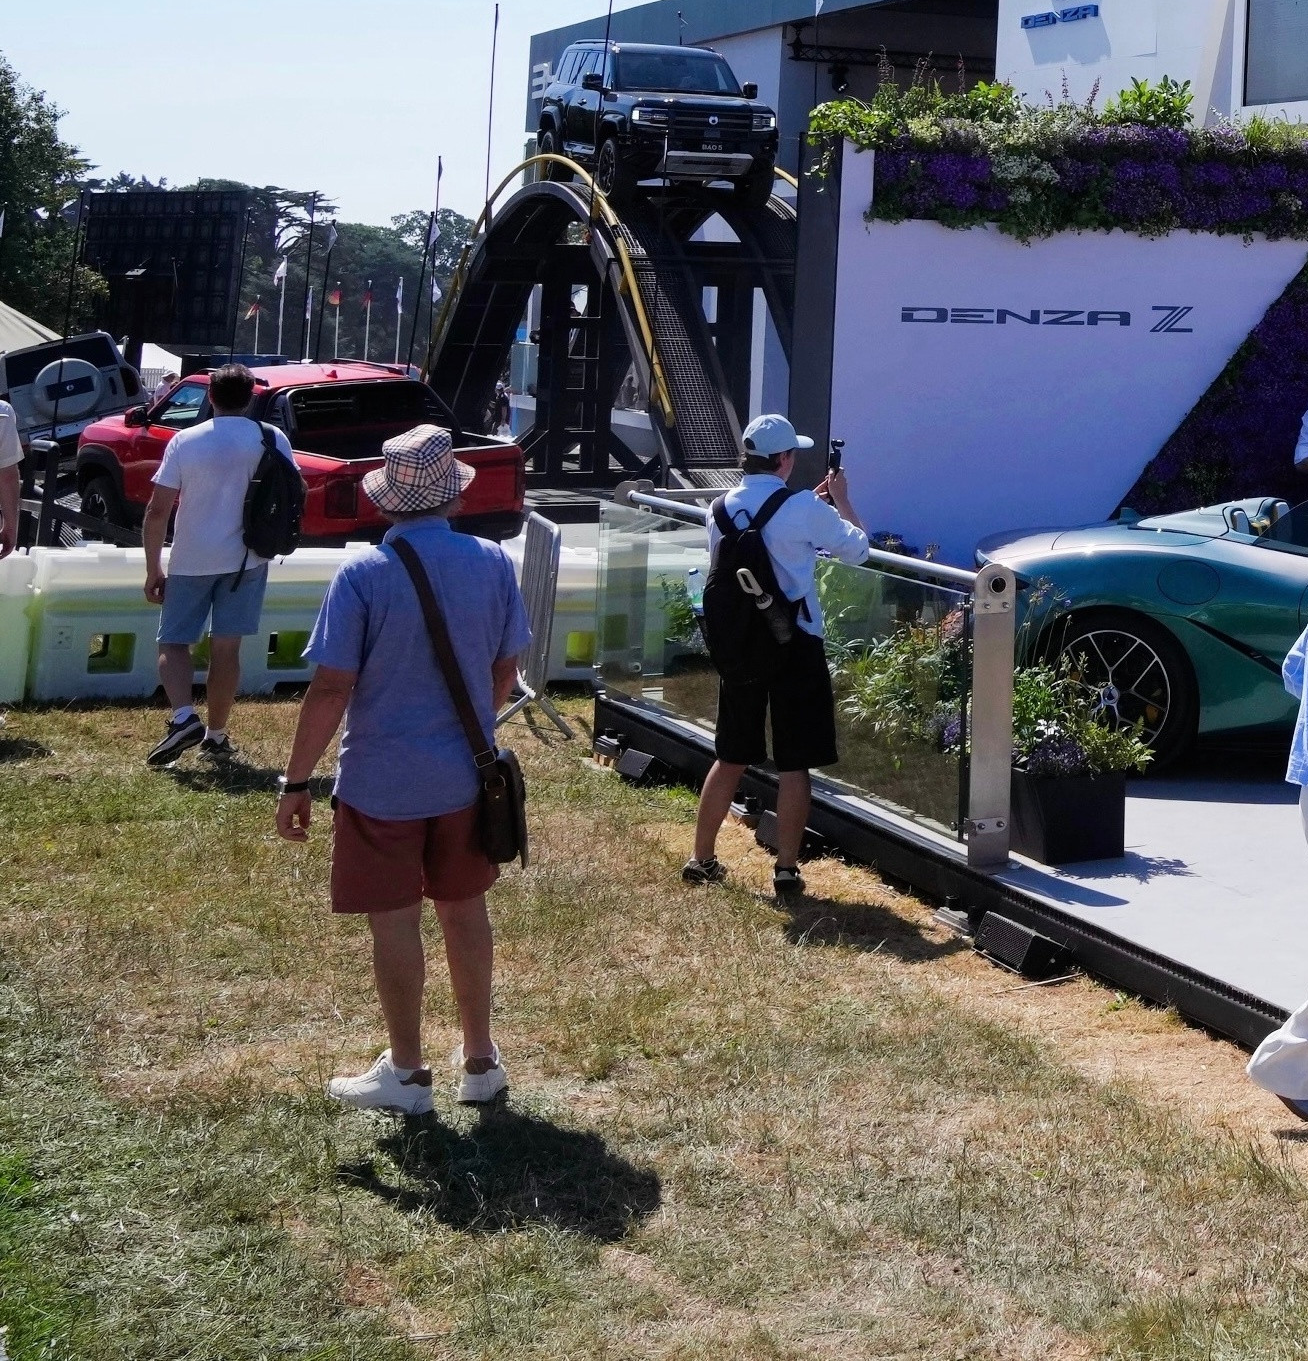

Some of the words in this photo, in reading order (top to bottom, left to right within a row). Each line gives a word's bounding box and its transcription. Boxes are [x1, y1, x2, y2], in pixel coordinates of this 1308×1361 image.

[1020, 4, 1099, 30] DENZA
[901, 306, 1131, 327] DENZA
[1150, 305, 1194, 333] Z
